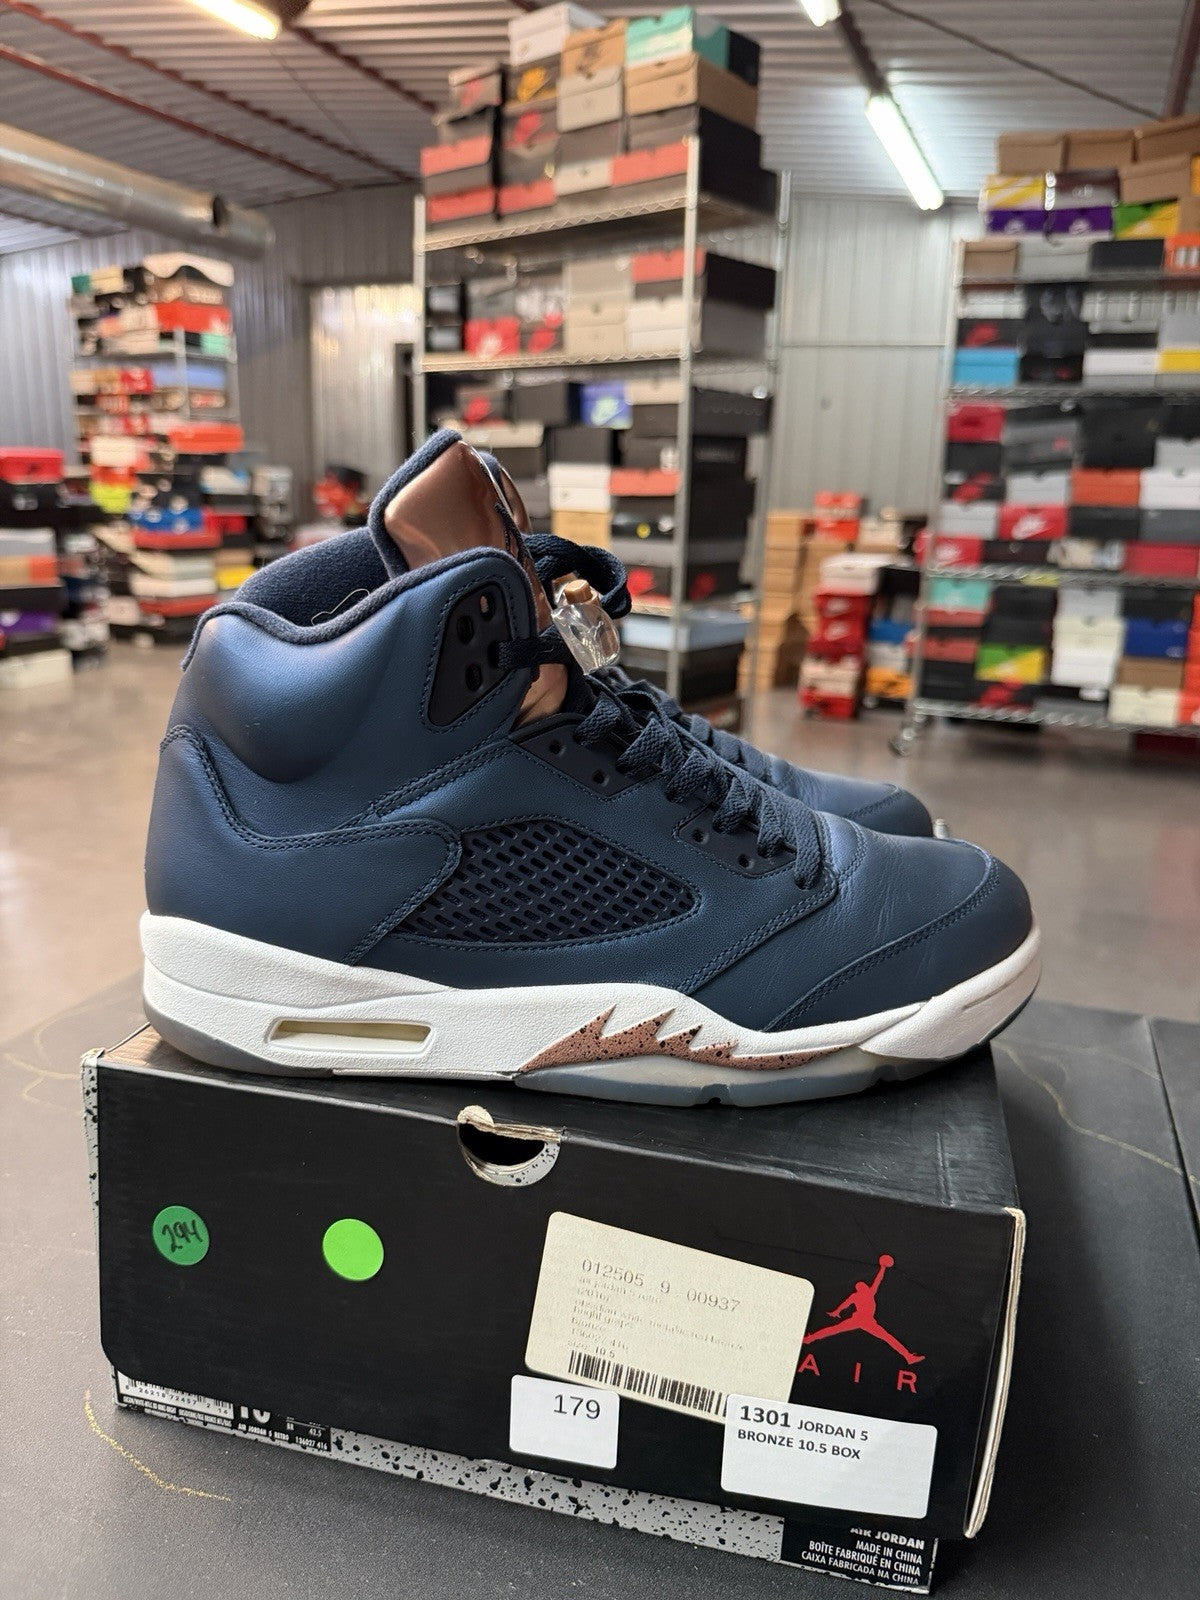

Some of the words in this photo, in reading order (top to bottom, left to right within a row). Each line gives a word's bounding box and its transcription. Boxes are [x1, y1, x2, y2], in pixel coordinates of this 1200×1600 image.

[162, 1220, 203, 1253] 294
[582, 1259, 645, 1287] 012505
[660, 1280, 671, 1294] 9
[686, 1288, 741, 1312] 00937
[797, 1353, 917, 1394] AIR
[554, 1394, 601, 1419] 179
[740, 1405, 791, 1428] 1301
[797, 1419, 856, 1440] JORDAN
[860, 1430, 869, 1441] 5
[248, 1425, 267, 1436] JORDAN
[737, 1429, 794, 1448] BRONZE
[798, 1439, 827, 1454] 10.5
[831, 1445, 861, 1460] BOX
[856, 1540, 881, 1555] MADE
[883, 1547, 893, 1558] IN
[895, 1549, 923, 1565] CHINA
[875, 1531, 925, 1550] JORDAN
[801, 1550, 826, 1565] CAIXA
[828, 1557, 875, 1576] FABRICADA
[877, 1569, 890, 1580] NA
[892, 1573, 919, 1586] CHINA
[808, 1540, 834, 1555] BOÎTE
[835, 1547, 878, 1566] FABRIQUÉ
[880, 1558, 891, 1570] EN
[894, 1561, 921, 1577] CHINA
